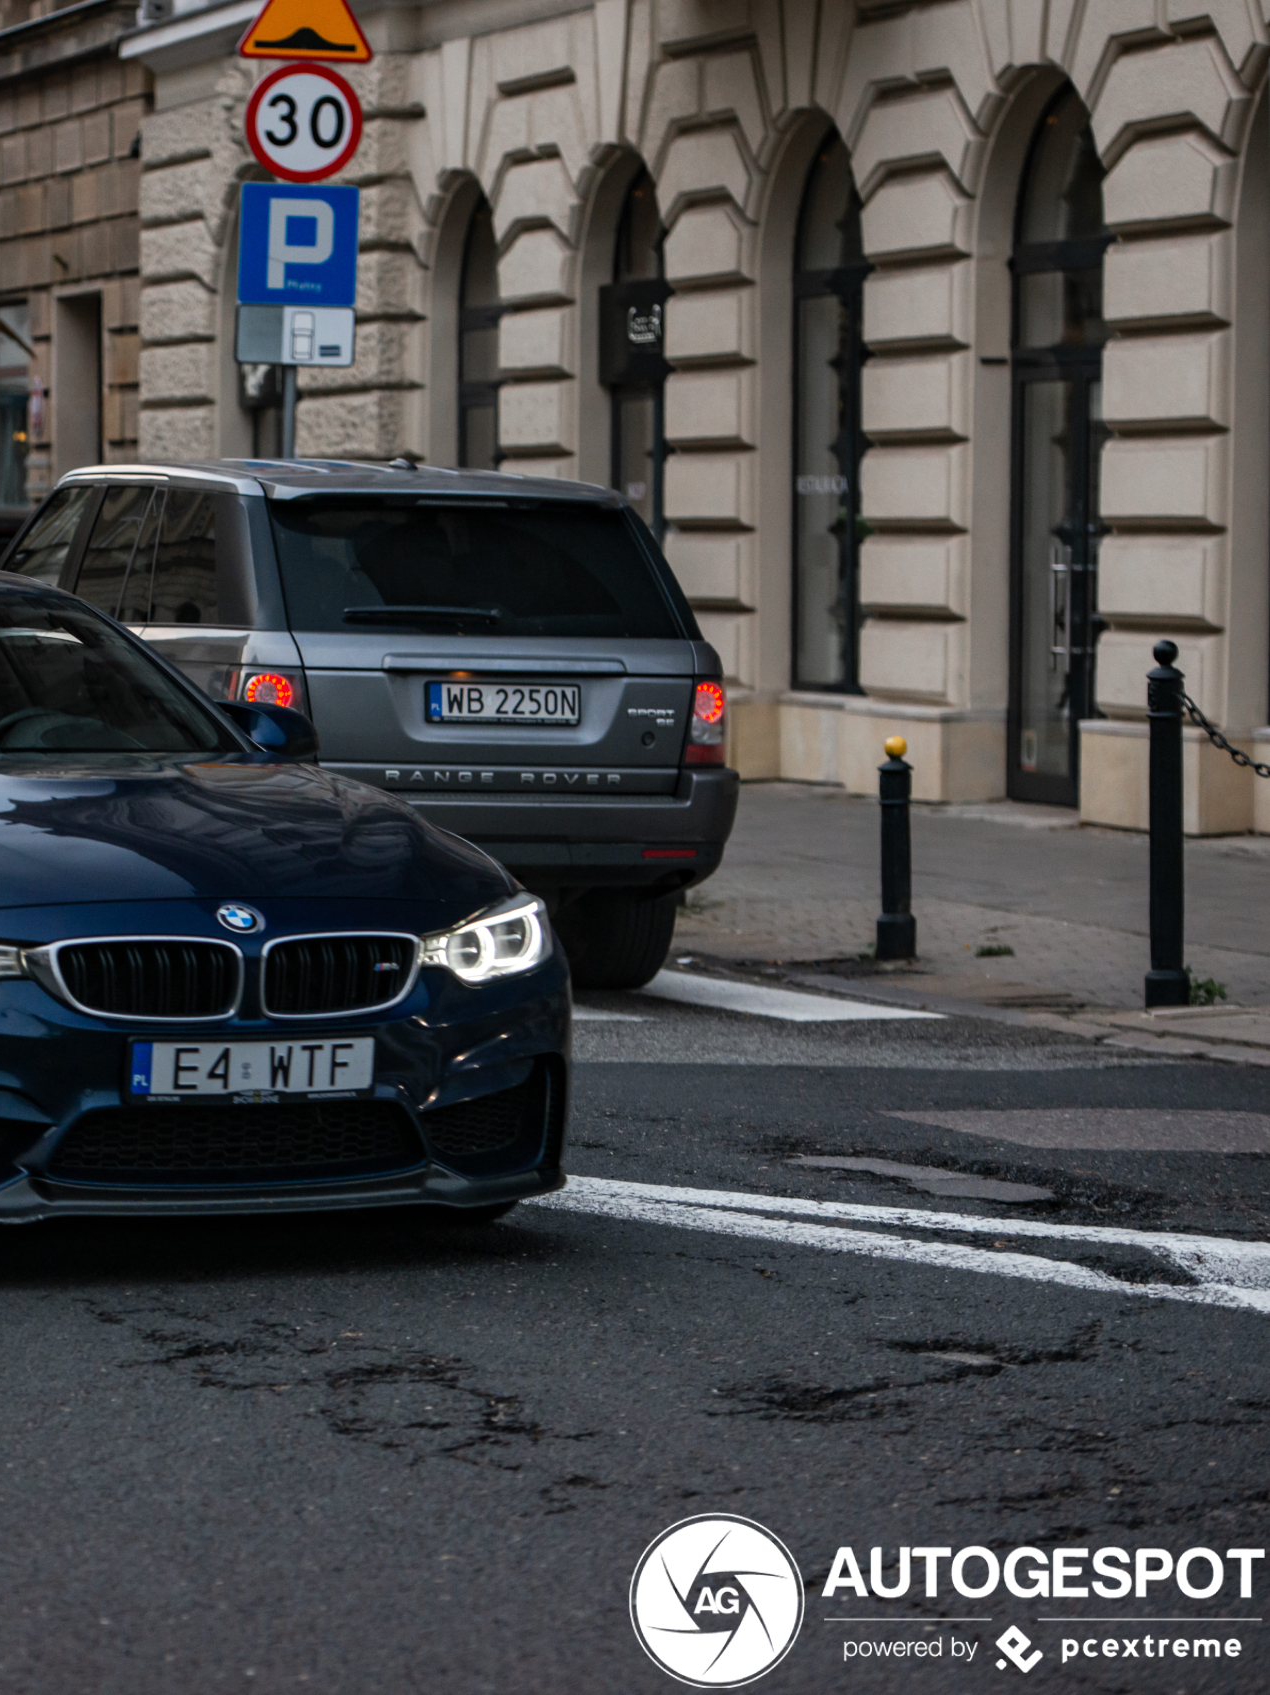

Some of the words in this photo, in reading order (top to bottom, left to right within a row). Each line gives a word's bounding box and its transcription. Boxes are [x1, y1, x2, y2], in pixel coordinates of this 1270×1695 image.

[265, 93, 345, 149] 30
[267, 198, 334, 289] P
[447, 687, 484, 714] WB
[496, 688, 577, 716] 2250N
[628, 708, 675, 717] SPORT
[385, 770, 494, 783] RANGE
[520, 773, 622, 786] ROVER
[133, 1074, 148, 1087] PL
[173, 1047, 231, 1090] E4
[270, 1043, 355, 1089] WTF
